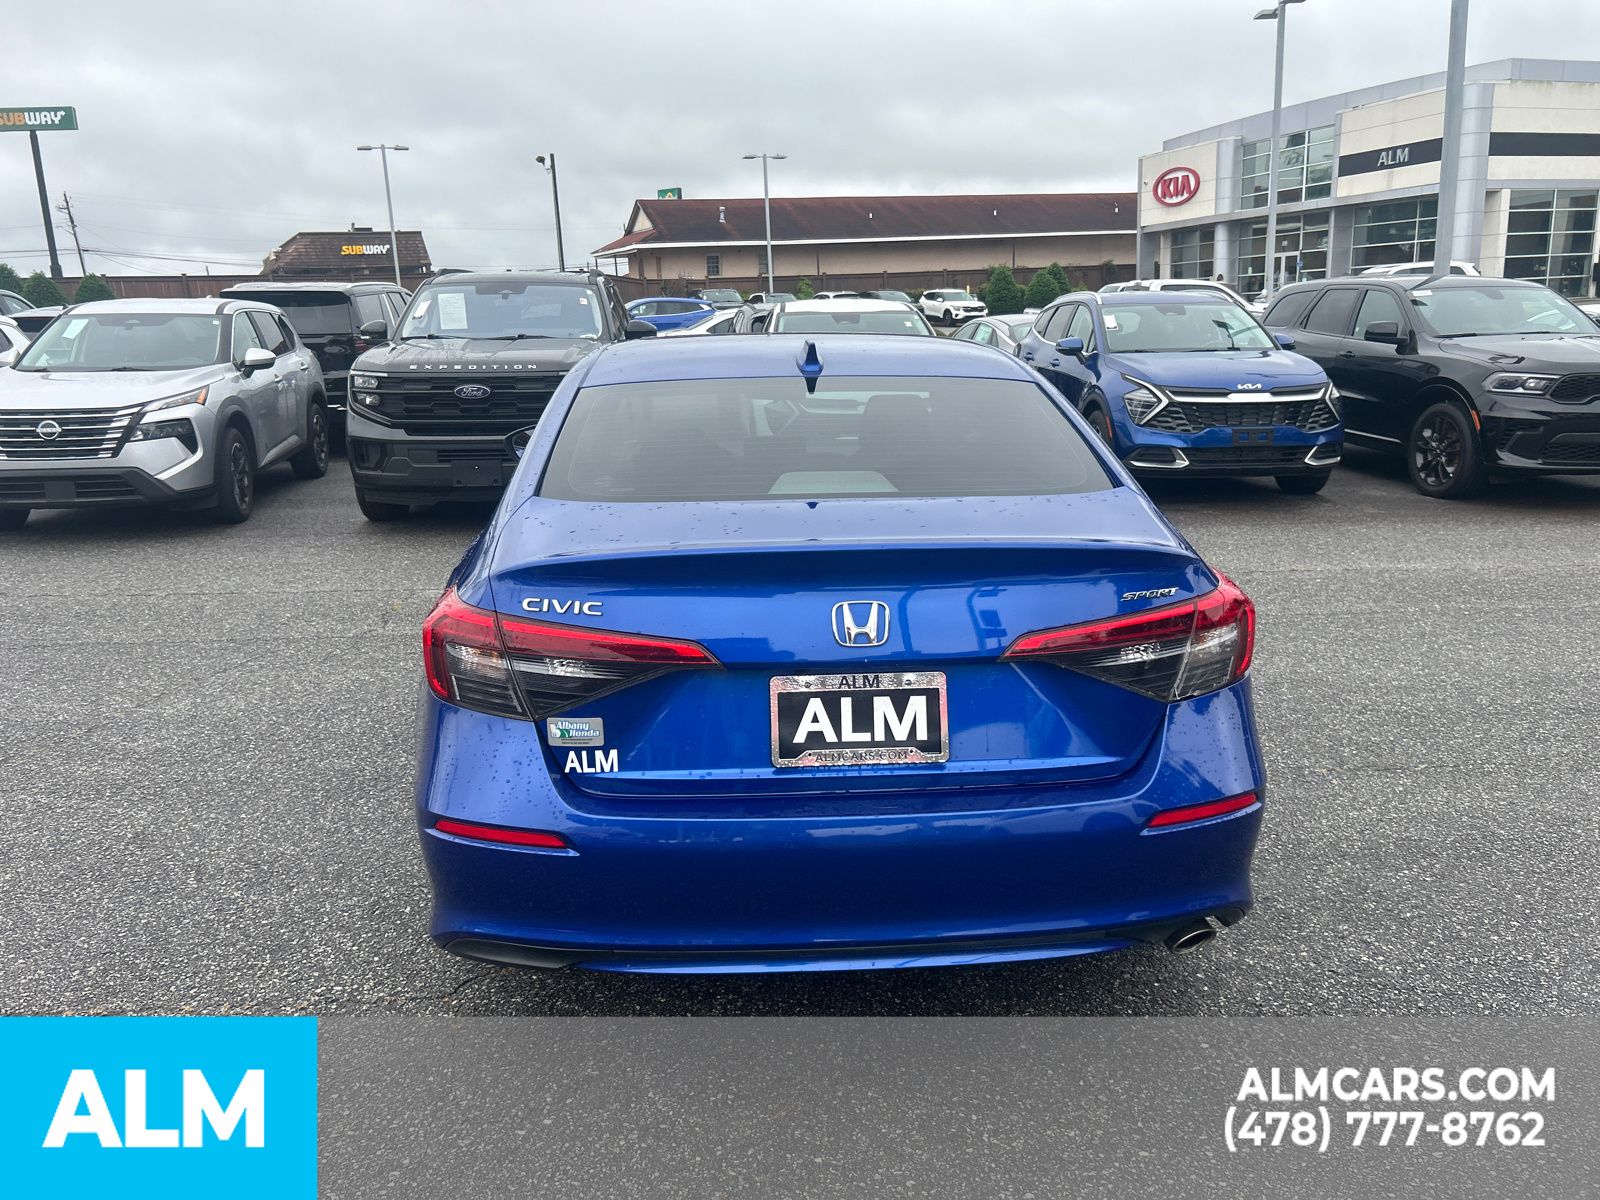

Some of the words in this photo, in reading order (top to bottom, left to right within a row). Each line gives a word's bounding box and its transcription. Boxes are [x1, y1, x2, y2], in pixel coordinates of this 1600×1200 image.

[1377, 147, 1409, 167] ALM
[1160, 174, 1192, 199] KIA
[340, 244, 391, 256] SUBWAY
[409, 363, 537, 371] EXPEDITION
[460, 387, 484, 397] Ford
[1120, 587, 1179, 602] SPORT
[522, 597, 603, 616] CIVIC
[838, 674, 880, 690] ALM
[556, 720, 590, 731] Albany
[792, 695, 928, 744] ALM
[569, 729, 600, 737] Honda
[564, 748, 619, 773] ALM
[815, 751, 908, 763] ALMCARS.COM
